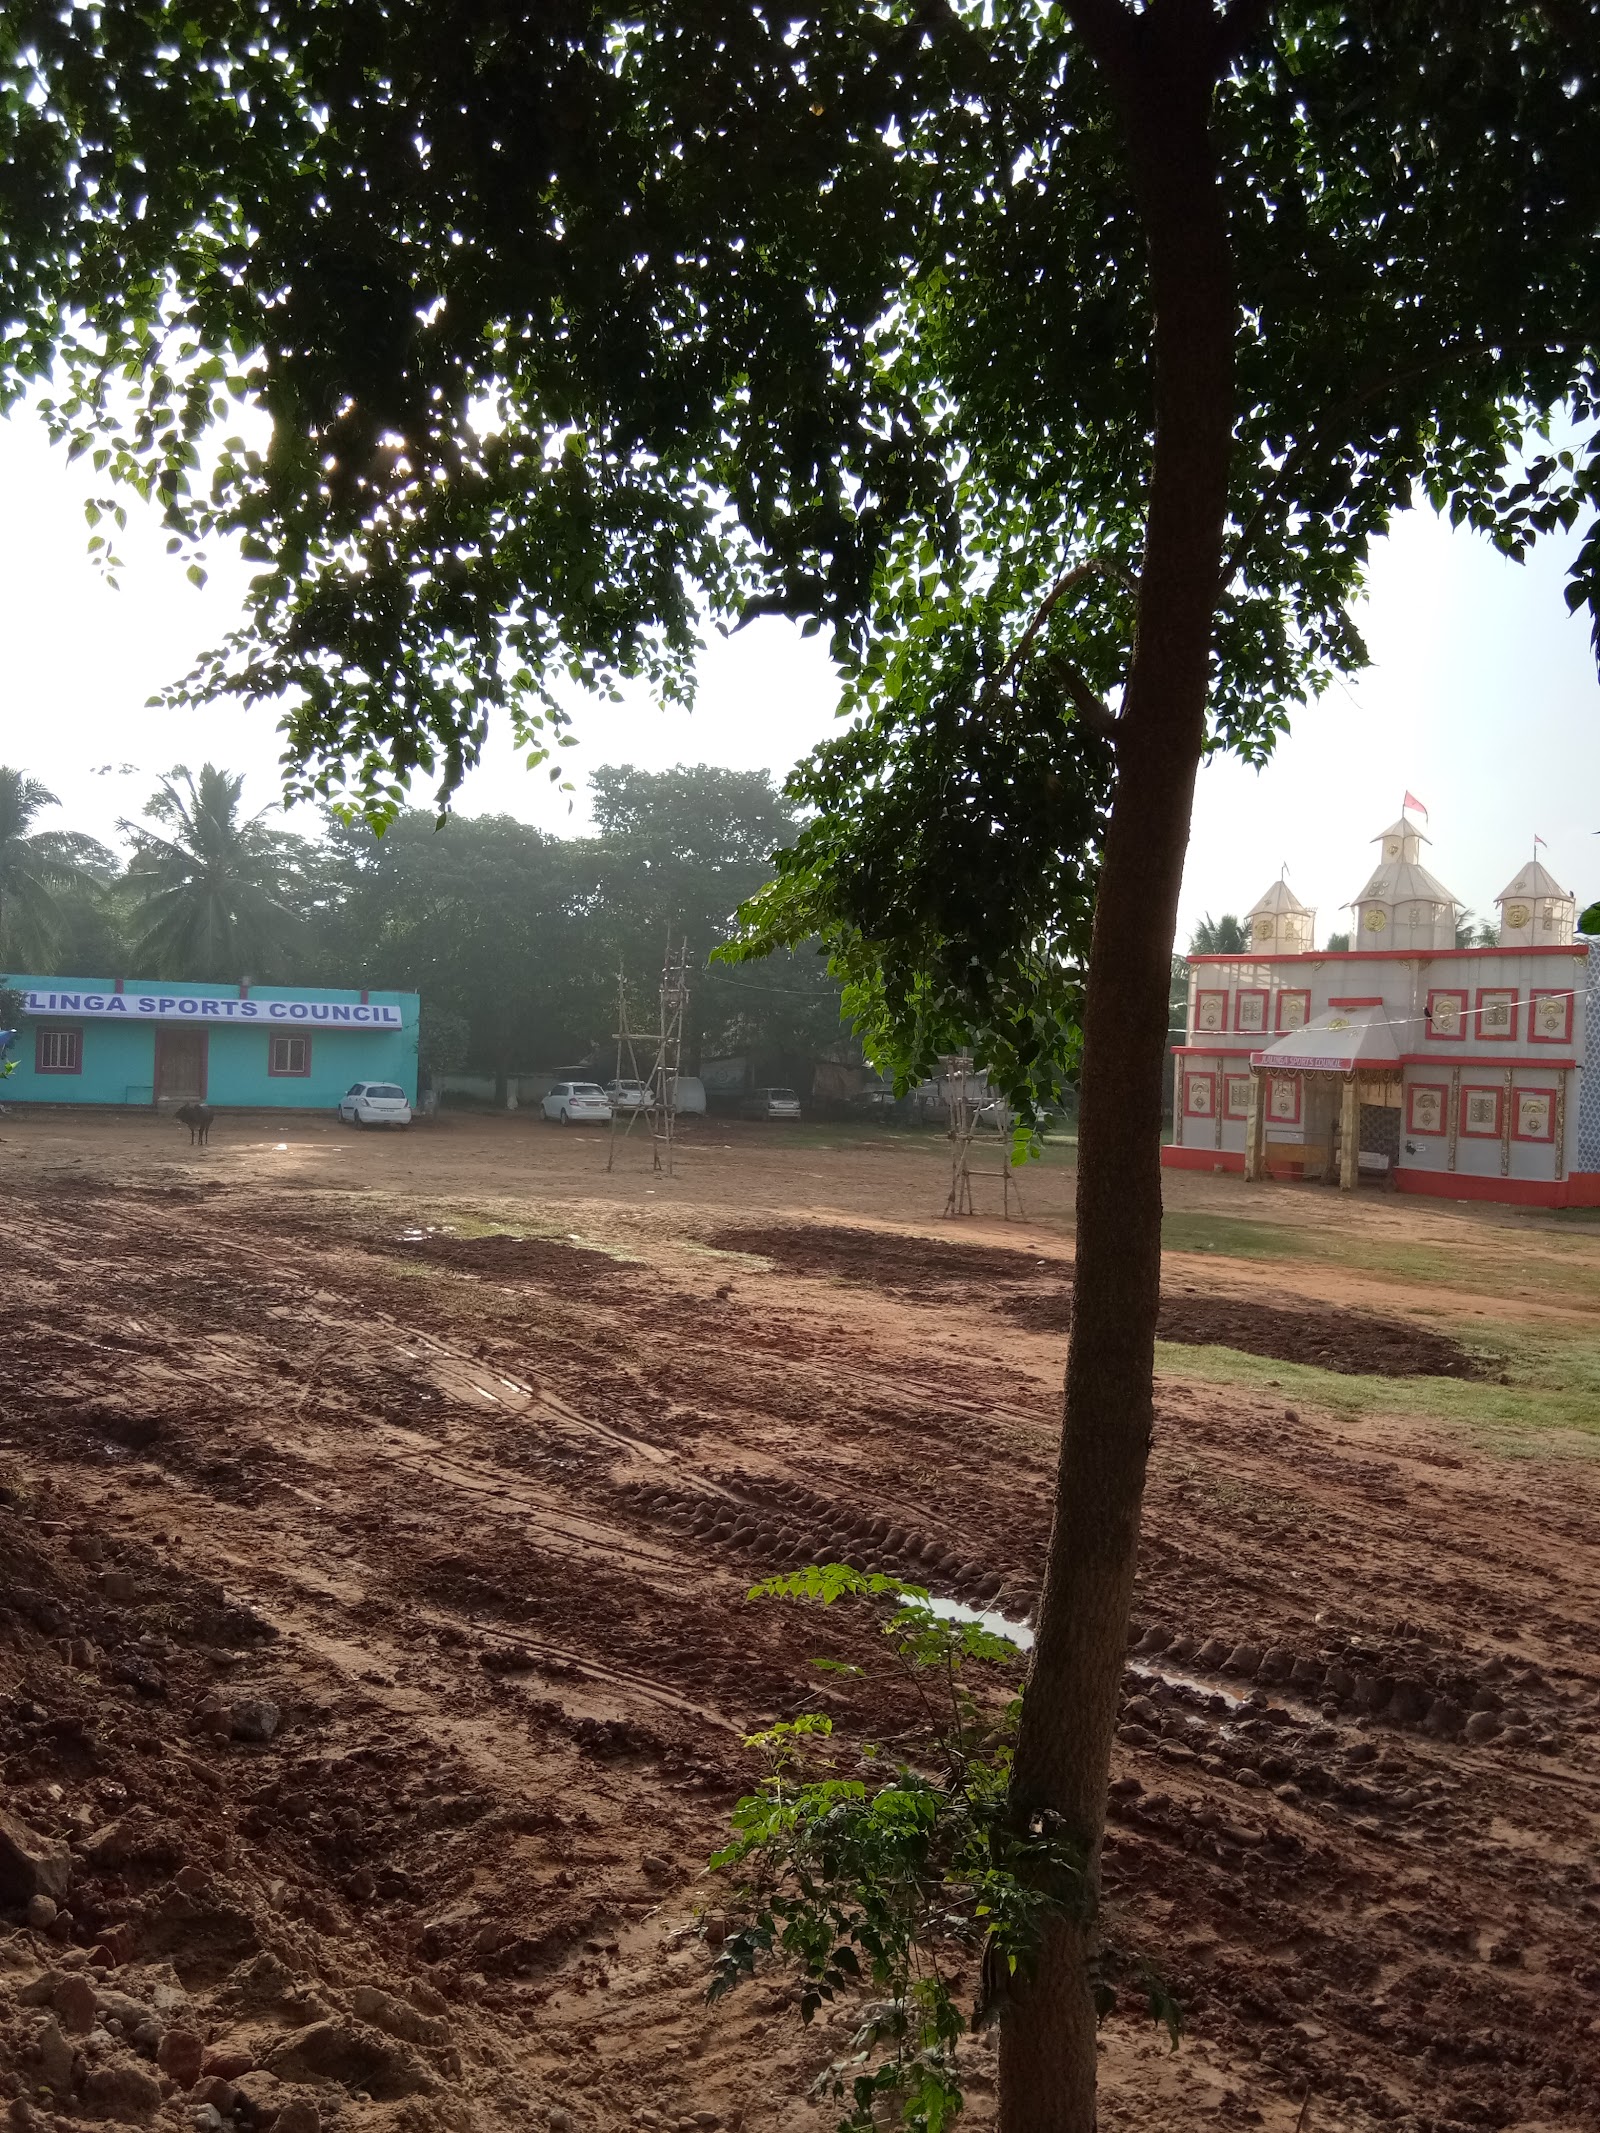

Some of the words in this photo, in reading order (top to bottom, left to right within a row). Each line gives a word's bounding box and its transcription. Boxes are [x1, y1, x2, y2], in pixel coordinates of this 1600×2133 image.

[29, 993, 127, 1012] LINGA
[138, 997, 258, 1017] SPORTS
[269, 1003, 398, 1022] COUNCIL
[1289, 1057, 1314, 1067] SPORTS
[1315, 1058, 1342, 1068] COUNCIL
